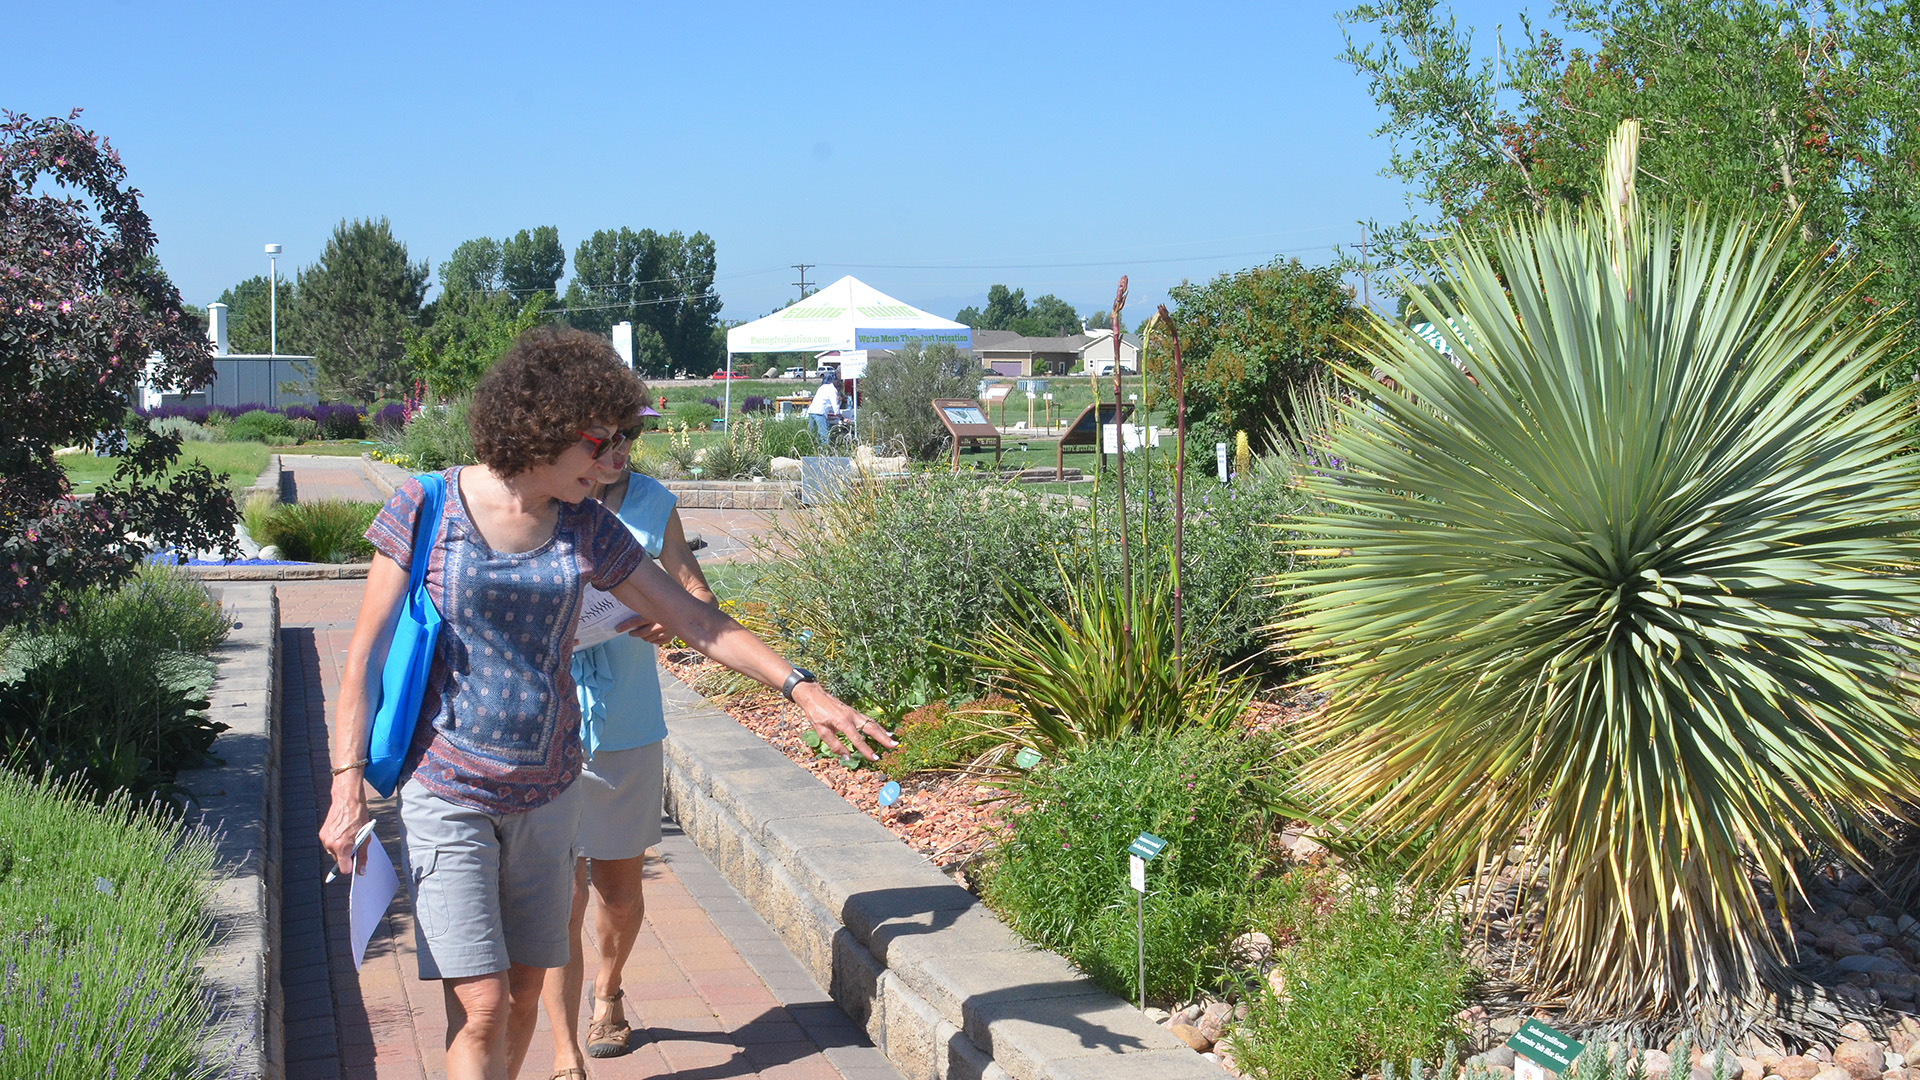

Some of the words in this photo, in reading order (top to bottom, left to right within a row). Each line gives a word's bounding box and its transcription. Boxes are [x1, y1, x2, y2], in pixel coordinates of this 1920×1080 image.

[750, 334, 831, 346] EwingIrrigation.com
[858, 335, 880, 343] We're
[881, 334, 900, 343] More
[921, 334, 935, 342] Just
[936, 333, 968, 343] Irrigation
